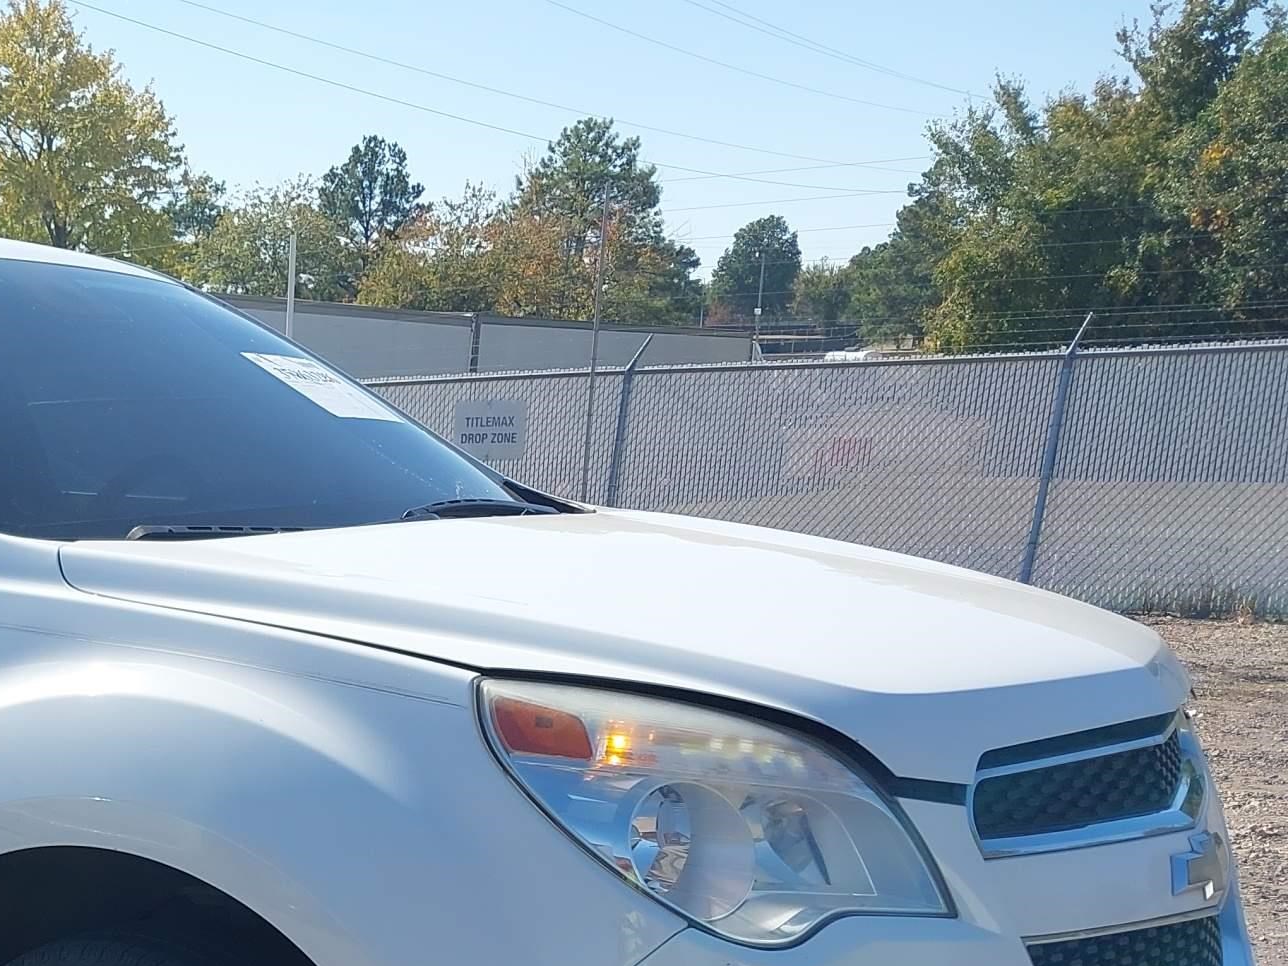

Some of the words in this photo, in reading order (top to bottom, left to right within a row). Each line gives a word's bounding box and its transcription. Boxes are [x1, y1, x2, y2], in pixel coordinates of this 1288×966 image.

[465, 416, 515, 428] TITLEMAX
[460, 432, 488, 444] DROP
[490, 432, 518, 444] ZONE
